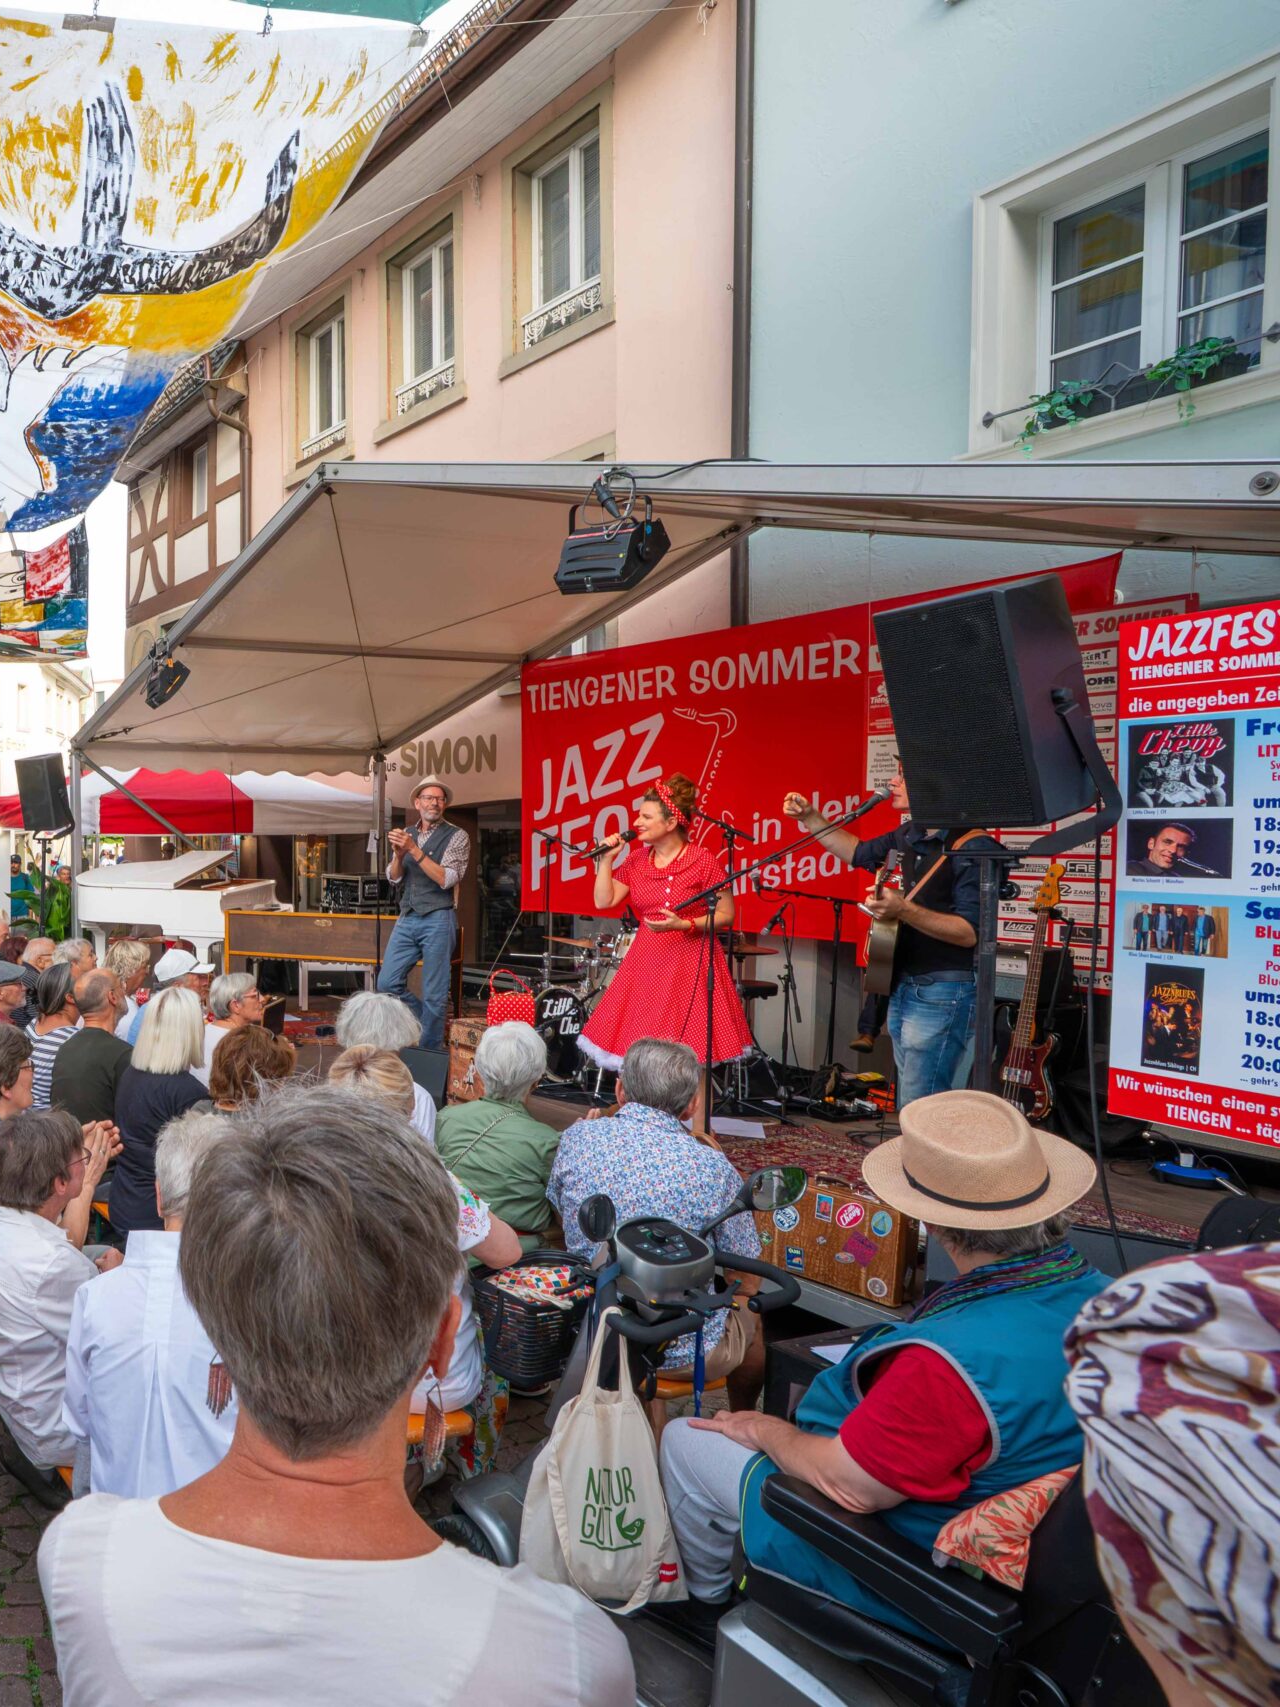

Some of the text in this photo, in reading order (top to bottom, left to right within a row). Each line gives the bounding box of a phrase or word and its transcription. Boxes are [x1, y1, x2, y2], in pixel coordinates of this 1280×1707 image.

[1128, 608, 1280, 662] JAZZFES
[526, 639, 862, 714] TIENGENER SOMMER
[1129, 659, 1214, 681] TIENGENER
[1128, 697, 1152, 713] die
[1156, 689, 1249, 713] angegeben
[1138, 728, 1227, 758] Chevy
[1170, 723, 1218, 738] Little
[400, 734, 497, 777] SIMON
[533, 712, 665, 821] JAZZ
[753, 812, 781, 845] in
[1116, 1074, 1139, 1091] Wir
[1143, 1081, 1212, 1105] wünschen
[1222, 1096, 1265, 1115] einen
[1166, 1104, 1232, 1130] TIENGEN
